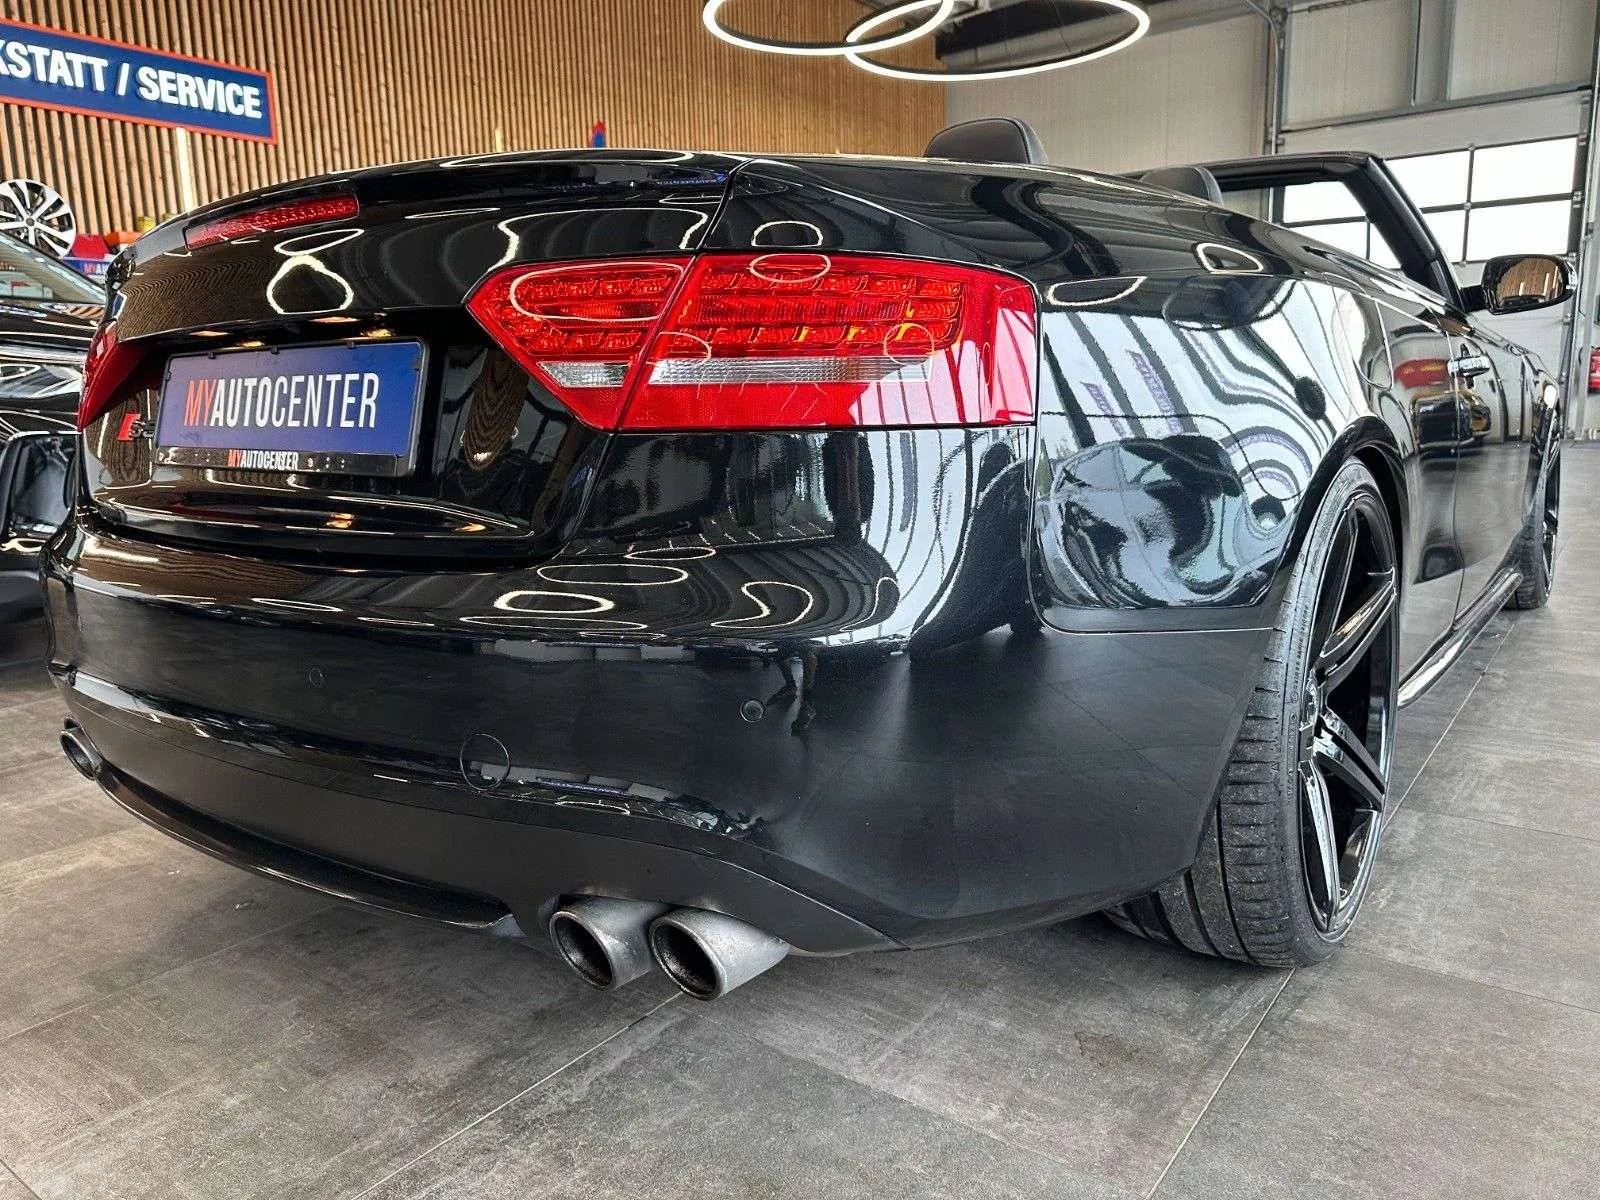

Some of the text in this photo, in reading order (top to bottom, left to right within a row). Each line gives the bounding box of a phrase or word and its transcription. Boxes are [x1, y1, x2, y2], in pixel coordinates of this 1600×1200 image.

[118, 63, 129, 96] /
[138, 66, 262, 119] SERVICE
[184, 372, 379, 428] MYAUTOCENTER
[228, 449, 299, 470] MYAUTOCENTER
